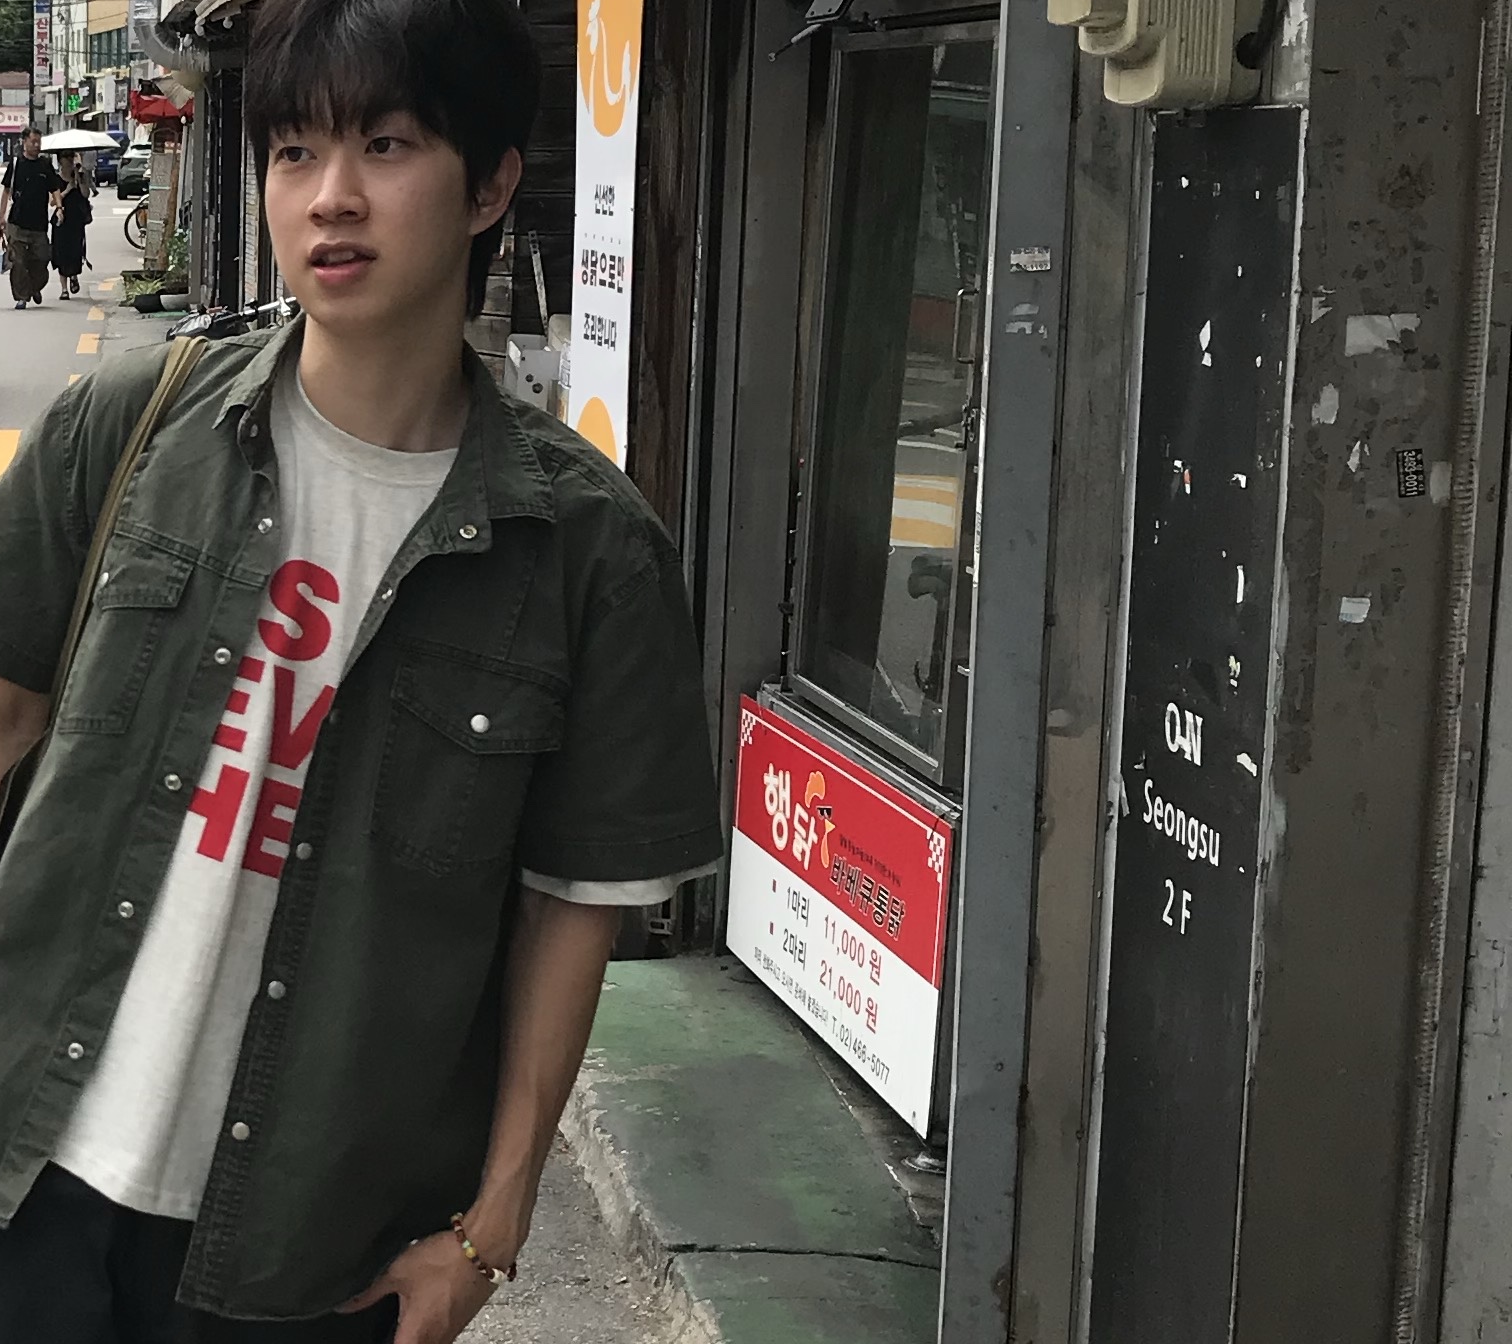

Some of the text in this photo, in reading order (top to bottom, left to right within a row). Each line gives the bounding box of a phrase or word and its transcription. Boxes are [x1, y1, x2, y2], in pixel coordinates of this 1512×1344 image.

[594, 184, 615, 216] 신선한
[581, 249, 625, 293] 생닭으로만
[583, 312, 617, 352] 조리합니다
[763, 763, 819, 871] 행닭
[1143, 779, 1220, 867] Seongsu
[786, 886, 883, 986] 1마리 11,000 원
[829, 853, 907, 941] 바베큐통닭
[782, 927, 880, 1035] 2마리 21,000 원
